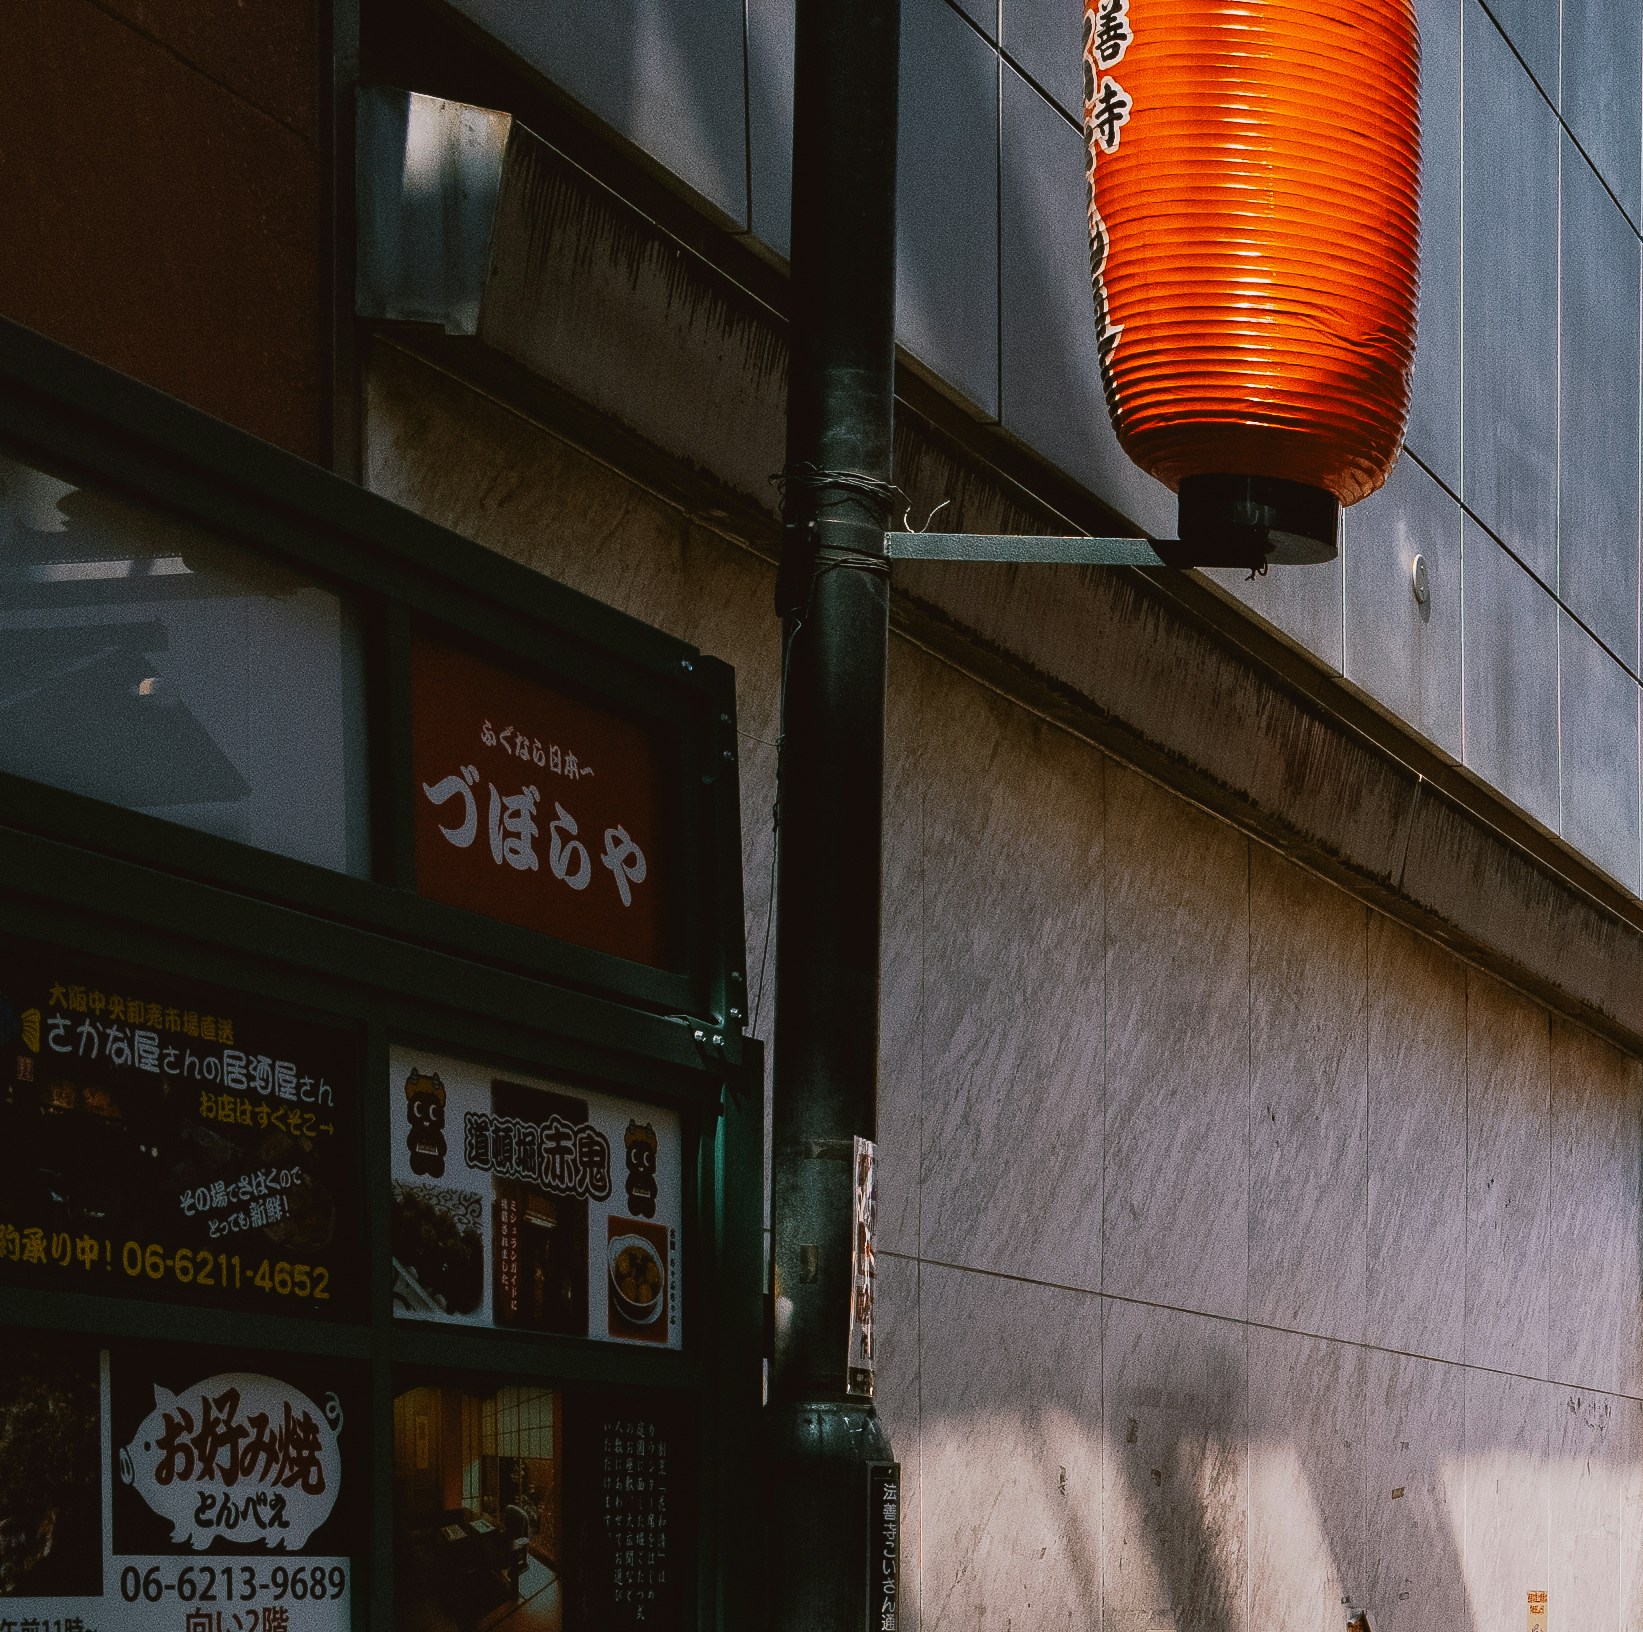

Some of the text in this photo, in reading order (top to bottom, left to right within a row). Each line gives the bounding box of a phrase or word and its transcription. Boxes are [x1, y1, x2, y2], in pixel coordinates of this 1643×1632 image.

[422, 765, 647, 907] づぼらや
[47, 1012, 334, 1107] さかな屋さんの居酒屋さん
[464, 1112, 612, 1201] 道頓堀赤鬼
[121, 1240, 331, 1299] 06-6211-4652
[154, 1387, 326, 1495] お好み焼
[120, 1566, 346, 1602] 06-6213-9689
